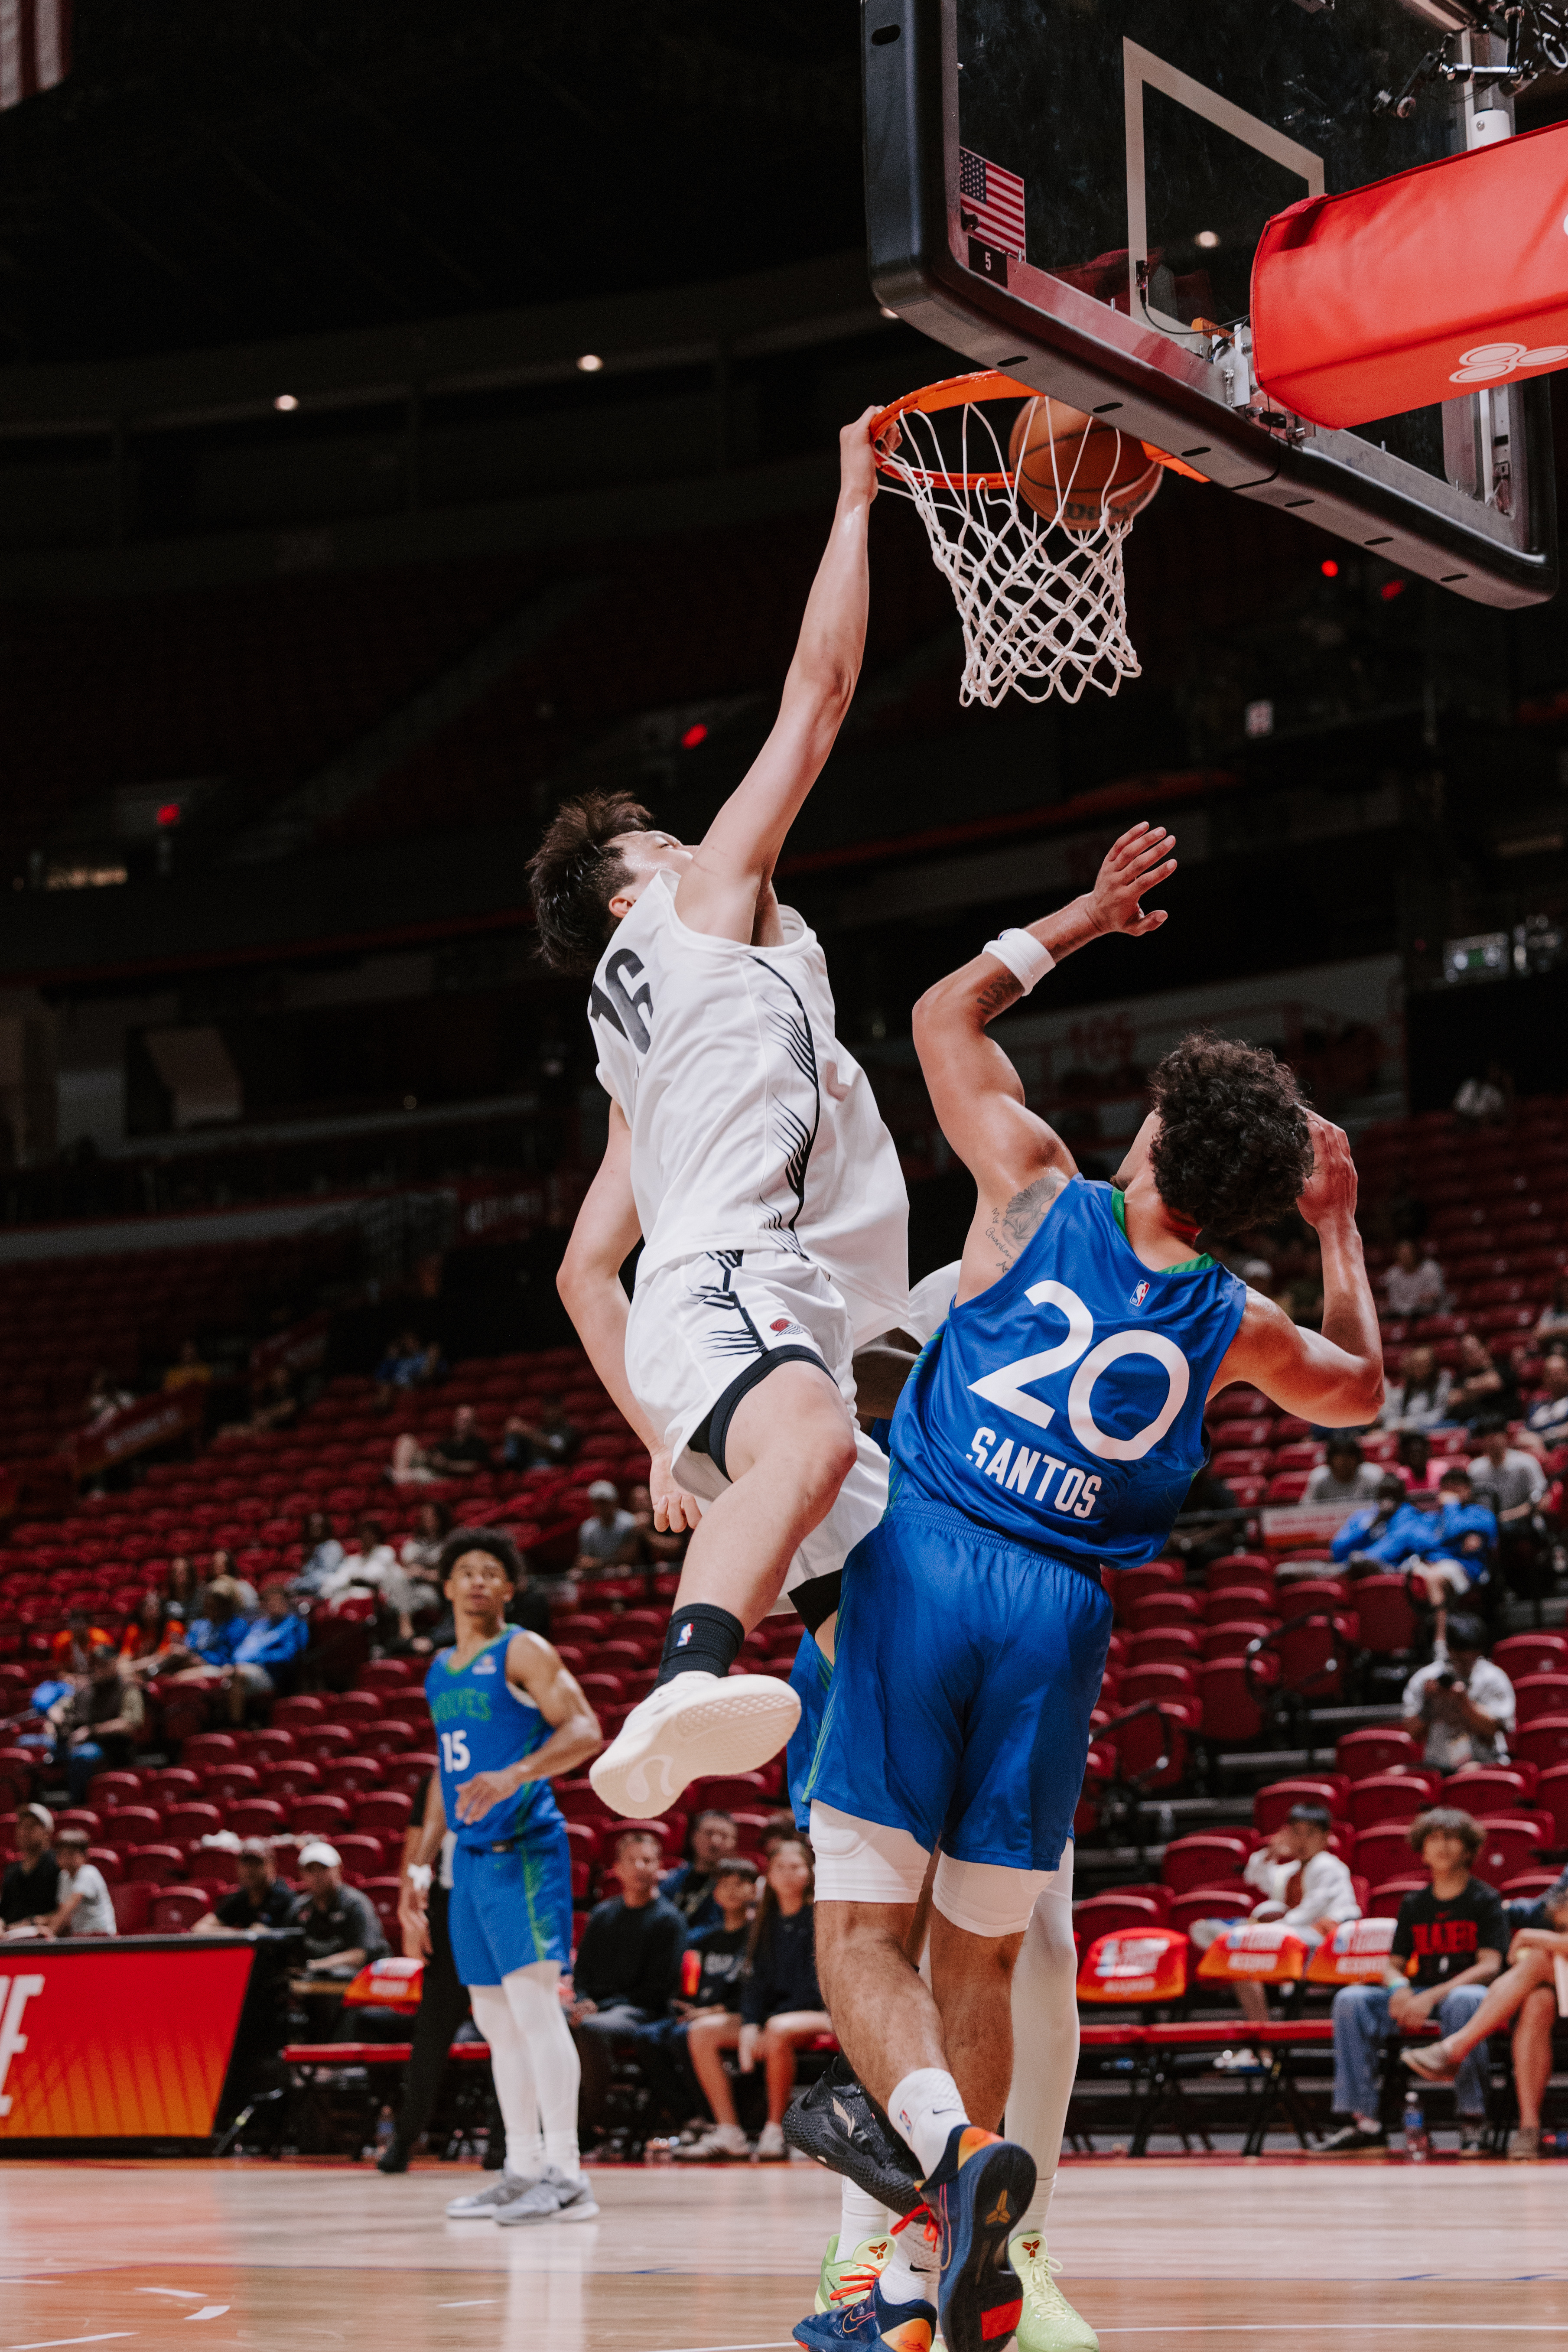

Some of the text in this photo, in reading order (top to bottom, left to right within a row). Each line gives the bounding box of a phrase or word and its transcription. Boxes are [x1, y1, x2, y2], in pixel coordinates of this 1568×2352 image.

[985, 251, 992, 271] 5
[992, 1207, 999, 1224] My
[986, 1227, 1013, 1259] Guardian
[967, 1280, 1190, 1461] 20
[966, 1426, 1102, 1518] SANTOS
[440, 1729, 471, 1773] 15
